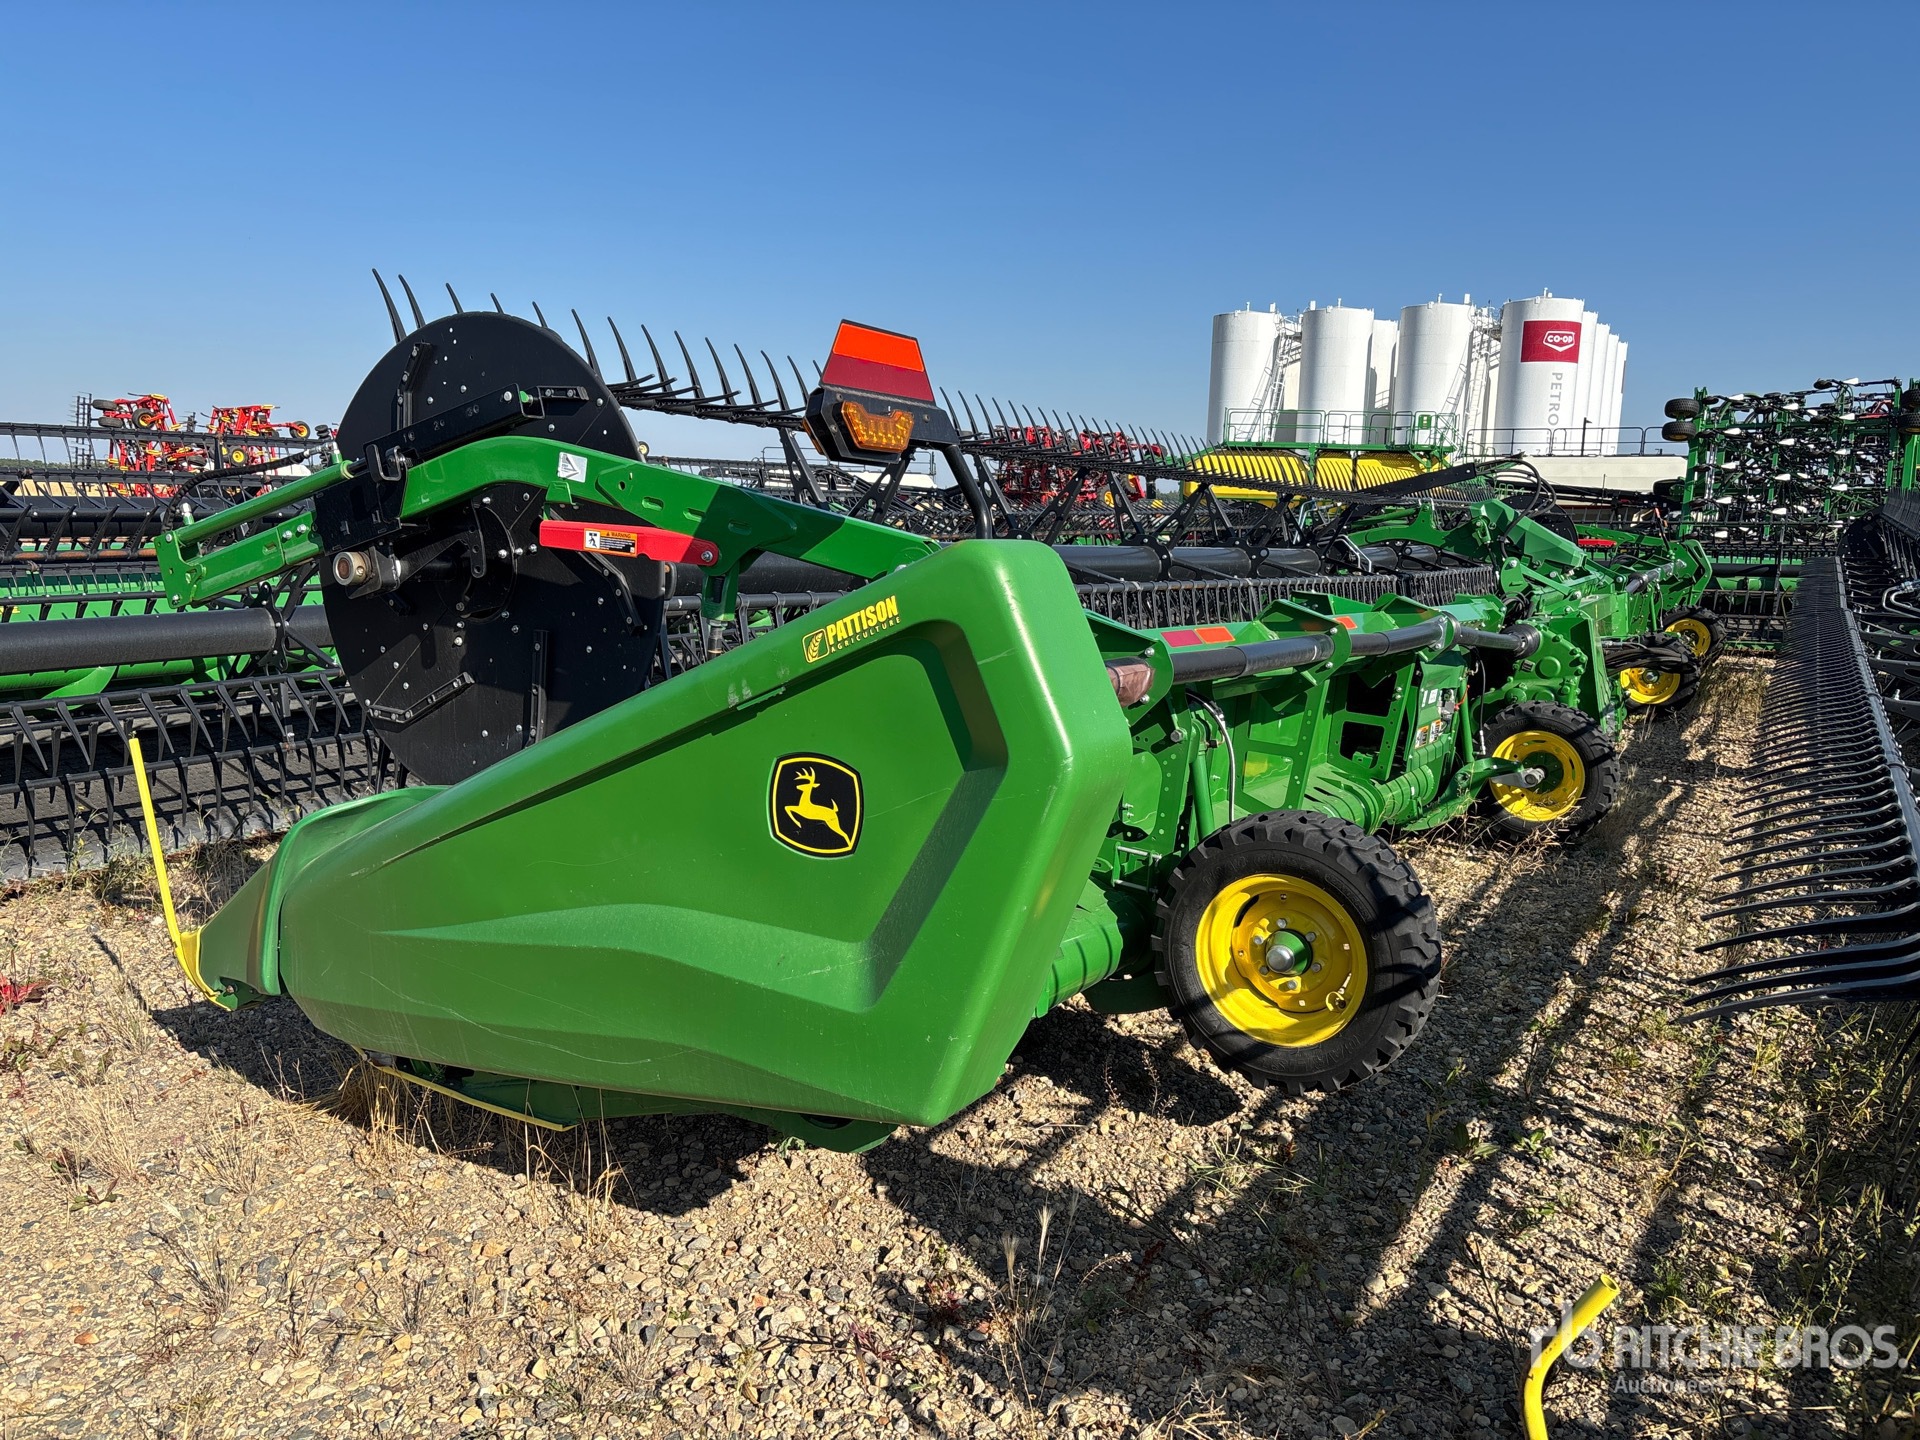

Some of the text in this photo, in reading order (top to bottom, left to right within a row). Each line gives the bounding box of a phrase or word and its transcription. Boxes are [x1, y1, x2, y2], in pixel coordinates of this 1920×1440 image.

[1546, 334, 1573, 344] CO-OP
[611, 531, 631, 539] WARNING
[826, 595, 898, 646] PATTISON
[831, 616, 900, 653] AGRICULTURE
